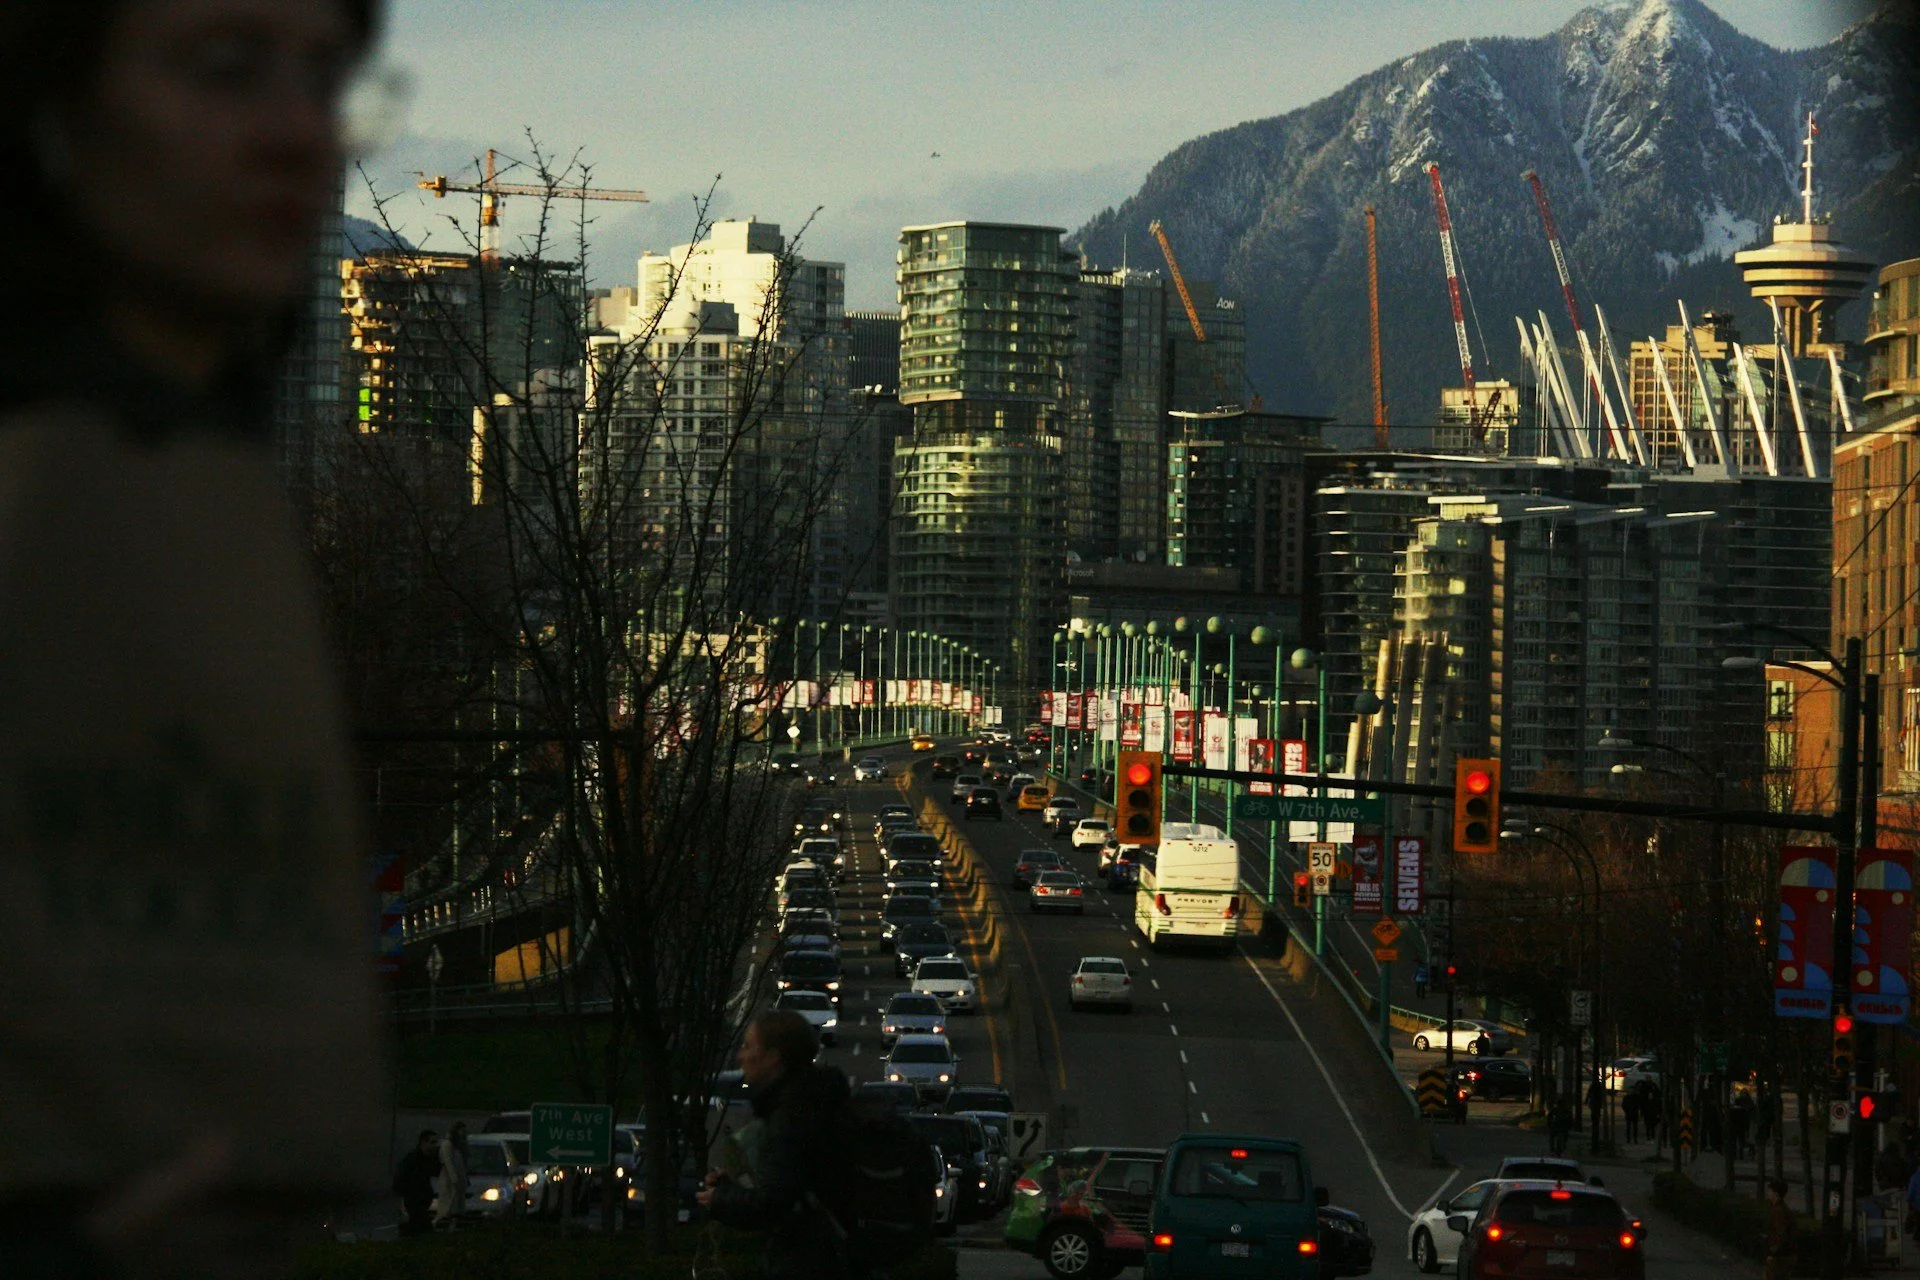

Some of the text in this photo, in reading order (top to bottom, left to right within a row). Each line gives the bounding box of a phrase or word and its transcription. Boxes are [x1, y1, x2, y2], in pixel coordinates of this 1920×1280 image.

[1278, 801, 1365, 819] W 7th Ave.
[1312, 852, 1331, 867] 50
[1397, 839, 1420, 912] SEVENS
[1355, 882, 1371, 892] THIS
[538, 1109, 604, 1125] 7th Ave
[548, 1126, 594, 1141] West
